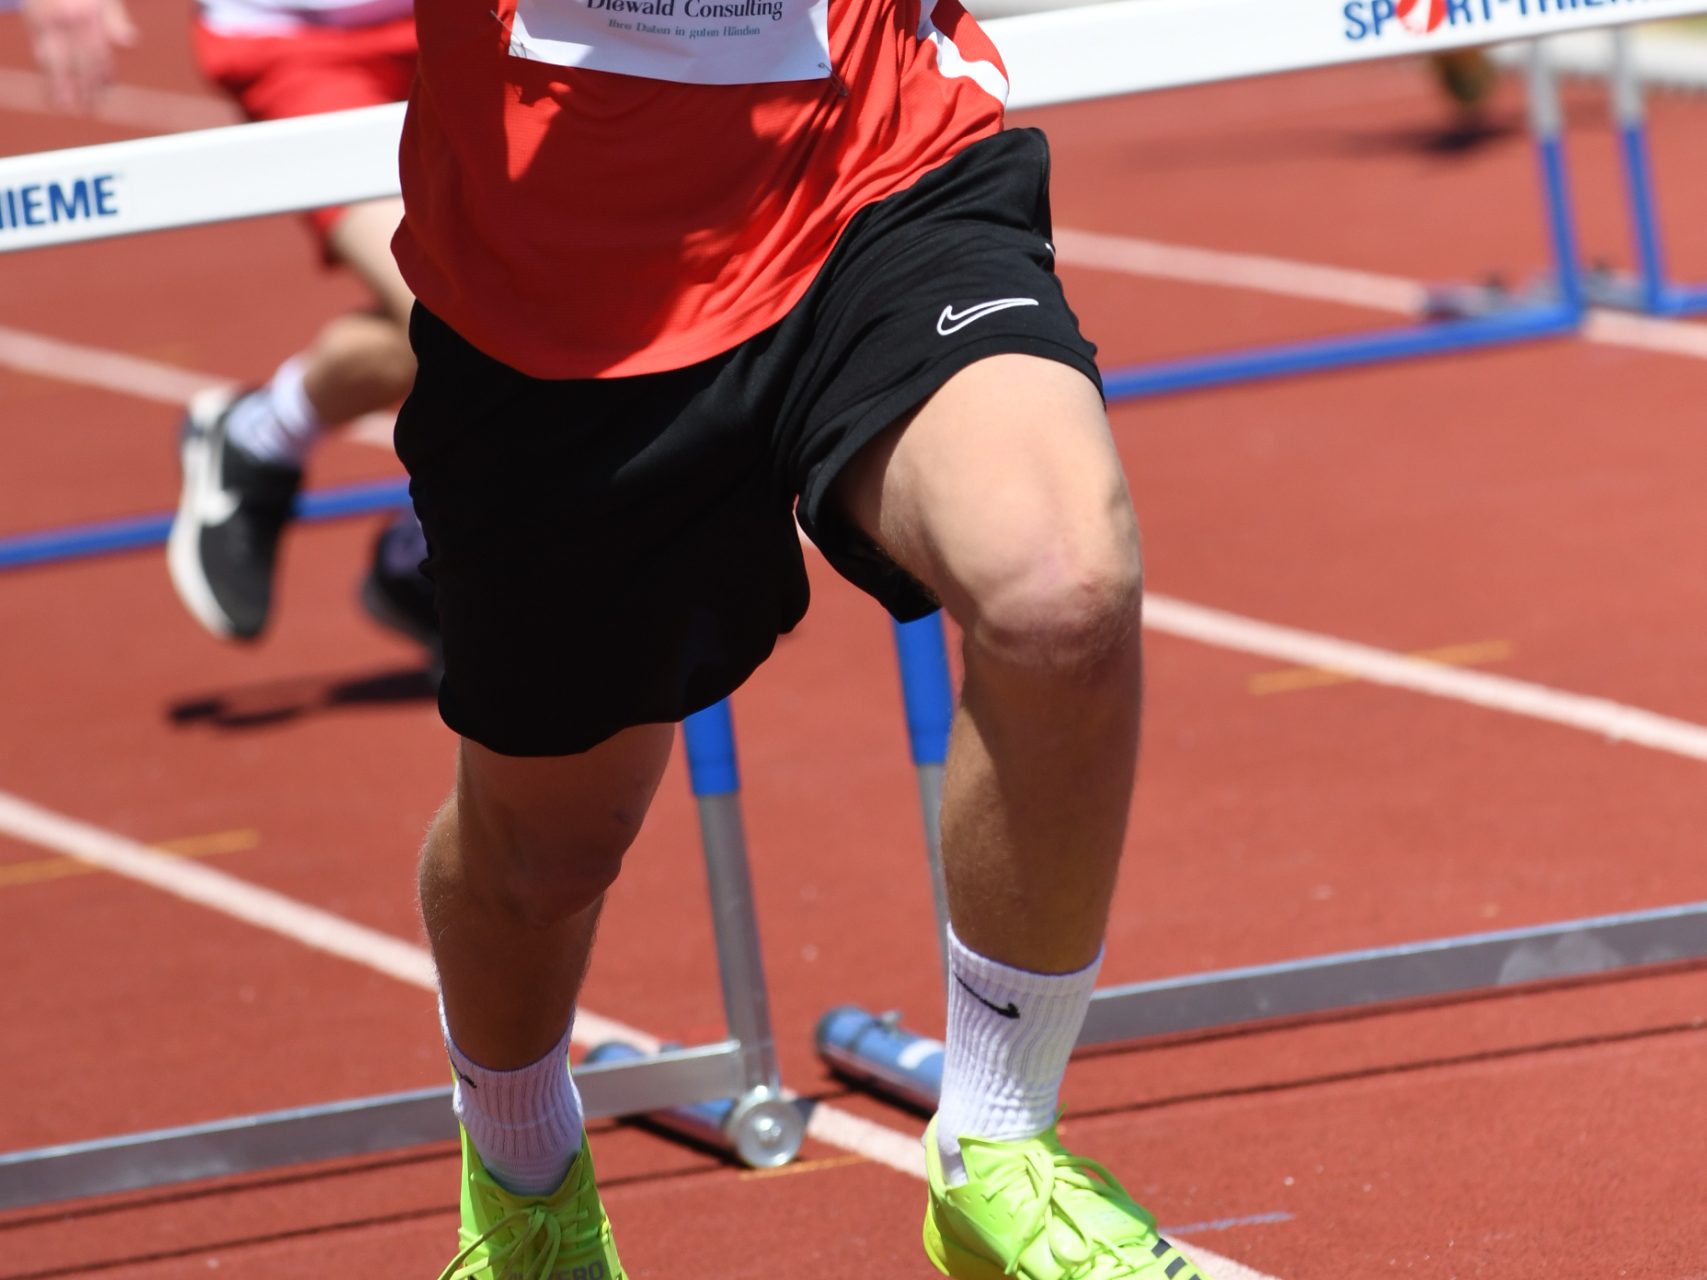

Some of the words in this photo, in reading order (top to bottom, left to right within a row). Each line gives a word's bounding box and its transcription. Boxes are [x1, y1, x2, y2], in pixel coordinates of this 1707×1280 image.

[608, 18, 632, 31] Ihre
[635, 22, 671, 36] Daten
[674, 25, 686, 37] in
[689, 27, 720, 40] guten
[0, 174, 118, 229] IEME
